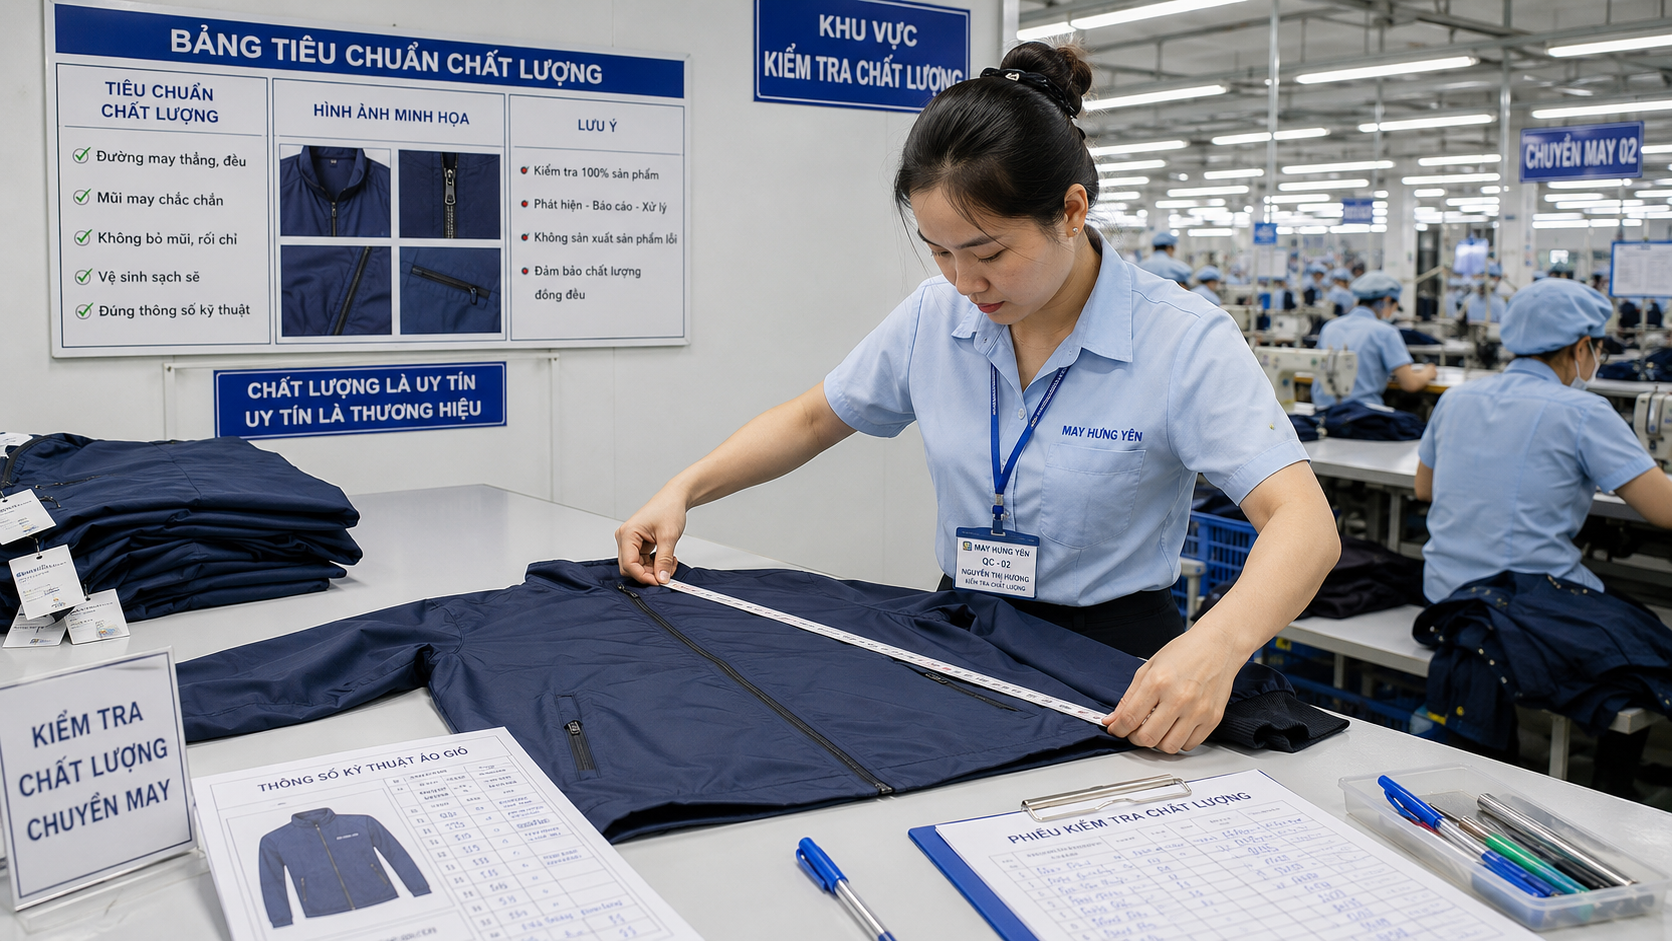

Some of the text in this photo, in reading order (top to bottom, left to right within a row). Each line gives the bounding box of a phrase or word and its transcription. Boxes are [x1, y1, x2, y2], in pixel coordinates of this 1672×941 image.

[819, 14, 918, 50] KHU VỰC
[171, 25, 602, 86] BẢNG TIÊU CHUẨN CHẤT LƯỢNG
[764, 43, 811, 80] KIỂM
[815, 56, 852, 84] TRA
[856, 54, 903, 88] CHẤT
[105, 79, 214, 101] TIÊU CHUẨN
[101, 102, 219, 125] CHẤT LƯỢNG
[314, 101, 352, 119] HÌNH
[395, 108, 433, 123] MINH
[438, 111, 470, 127] HỌA
[578, 118, 618, 133] LƯU Ý
[96, 150, 144, 166] Đường
[148, 154, 176, 167] may
[223, 153, 247, 167] đều
[1584, 138, 1617, 167] MAY
[1619, 137, 1638, 165] 02
[564, 167, 578, 177] tra
[582, 167, 609, 178] 100%
[612, 168, 629, 179] sản
[97, 191, 122, 204] Mũi
[127, 195, 155, 207] may
[534, 198, 558, 210] Phát
[561, 199, 582, 212] hiện
[592, 200, 612, 211] Báo
[615, 201, 633, 212] cáo
[659, 202, 667, 214] lý
[98, 231, 142, 247] Không
[146, 231, 163, 244] bỏ
[198, 232, 215, 245] rối
[219, 233, 237, 245] chỉ
[534, 232, 568, 245] Không
[571, 232, 589, 243] sản
[591, 231, 613, 244] xuất
[616, 233, 633, 244] sản
[98, 270, 116, 286] Vệ
[120, 271, 147, 283] sinh
[152, 271, 182, 285] sạch
[534, 264, 641, 279] Đảm bảo chất lượng
[565, 288, 586, 300] đều
[99, 302, 250, 319] Đúng thông số kỹ thuật
[247, 371, 476, 399] CHẤT LƯỢNG LÀ UY TÍN
[245, 397, 482, 427] UY TÍN LÀ THƯƠNG HIỆU
[1061, 425, 1143, 441] MAY HƯNG YÊN
[974, 543, 990, 552] MAY
[982, 557, 995, 567] QC
[1001, 559, 1011, 569] 02
[31, 701, 144, 749] KIỂM TRA
[19, 738, 168, 797] CHẤT LƯỢNG
[257, 775, 314, 792] THÔNG
[318, 767, 339, 781] SỐ
[366, 756, 414, 772] THUẬT
[443, 746, 468, 758] GIÓ
[27, 778, 171, 841] CHUYỀN MAY
[1107, 812, 1146, 825] TRA
[1191, 792, 1252, 808] LƯỢNG
